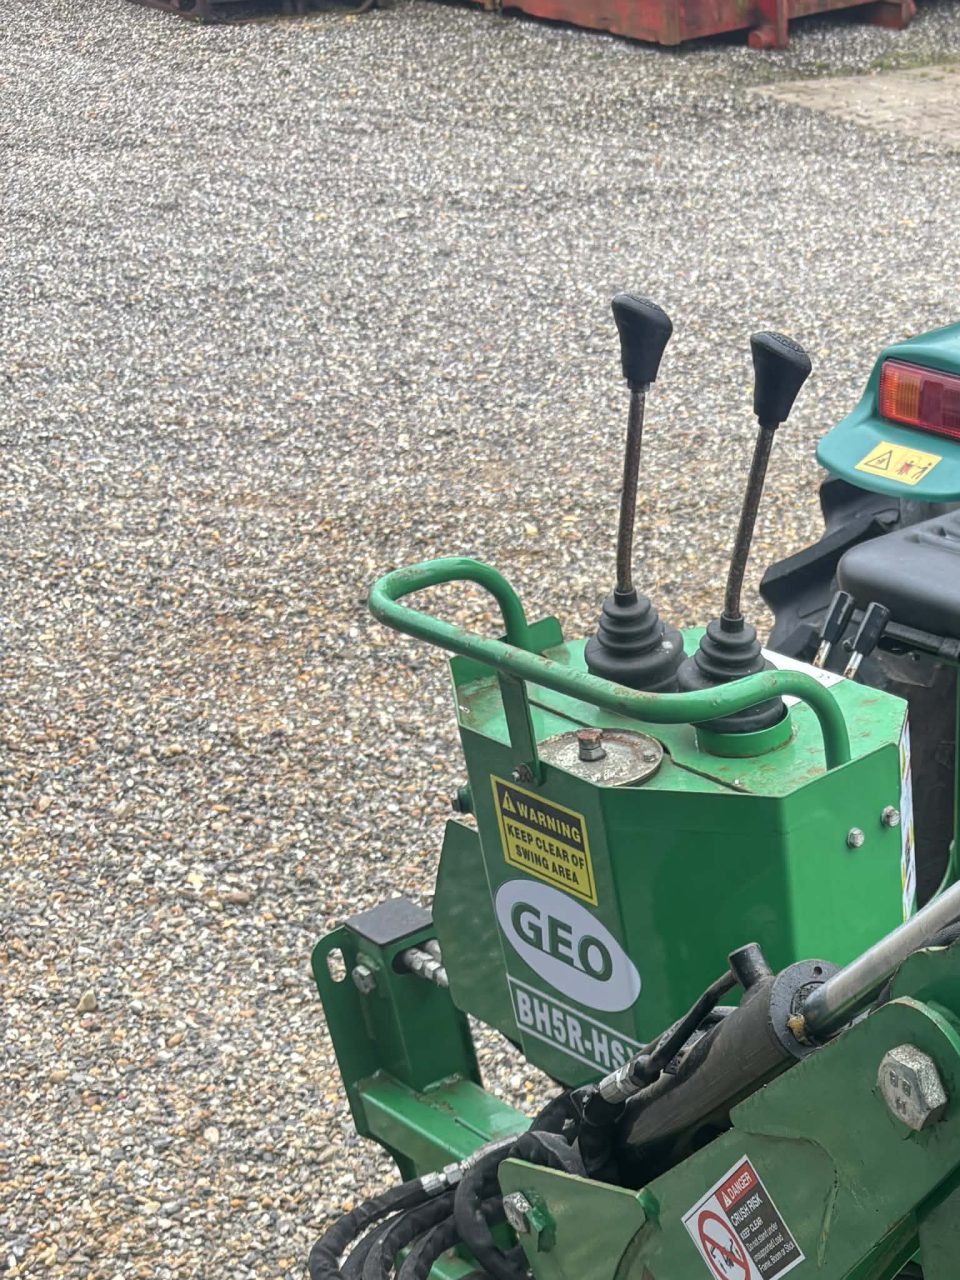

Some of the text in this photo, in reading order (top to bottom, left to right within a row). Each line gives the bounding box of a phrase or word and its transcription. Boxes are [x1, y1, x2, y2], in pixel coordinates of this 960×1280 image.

[516, 801, 581, 844] WARNING
[507, 823, 585, 870] KEEP CLEAR OF
[515, 845, 579, 885] SWING AREA
[511, 901, 613, 982] GEO
[516, 989, 634, 1070] BH5R-HS
[727, 1171, 752, 1200] DANGER
[730, 1192, 763, 1227] CRUSH RISK
[740, 1216, 763, 1240] KEEP CLEAR
